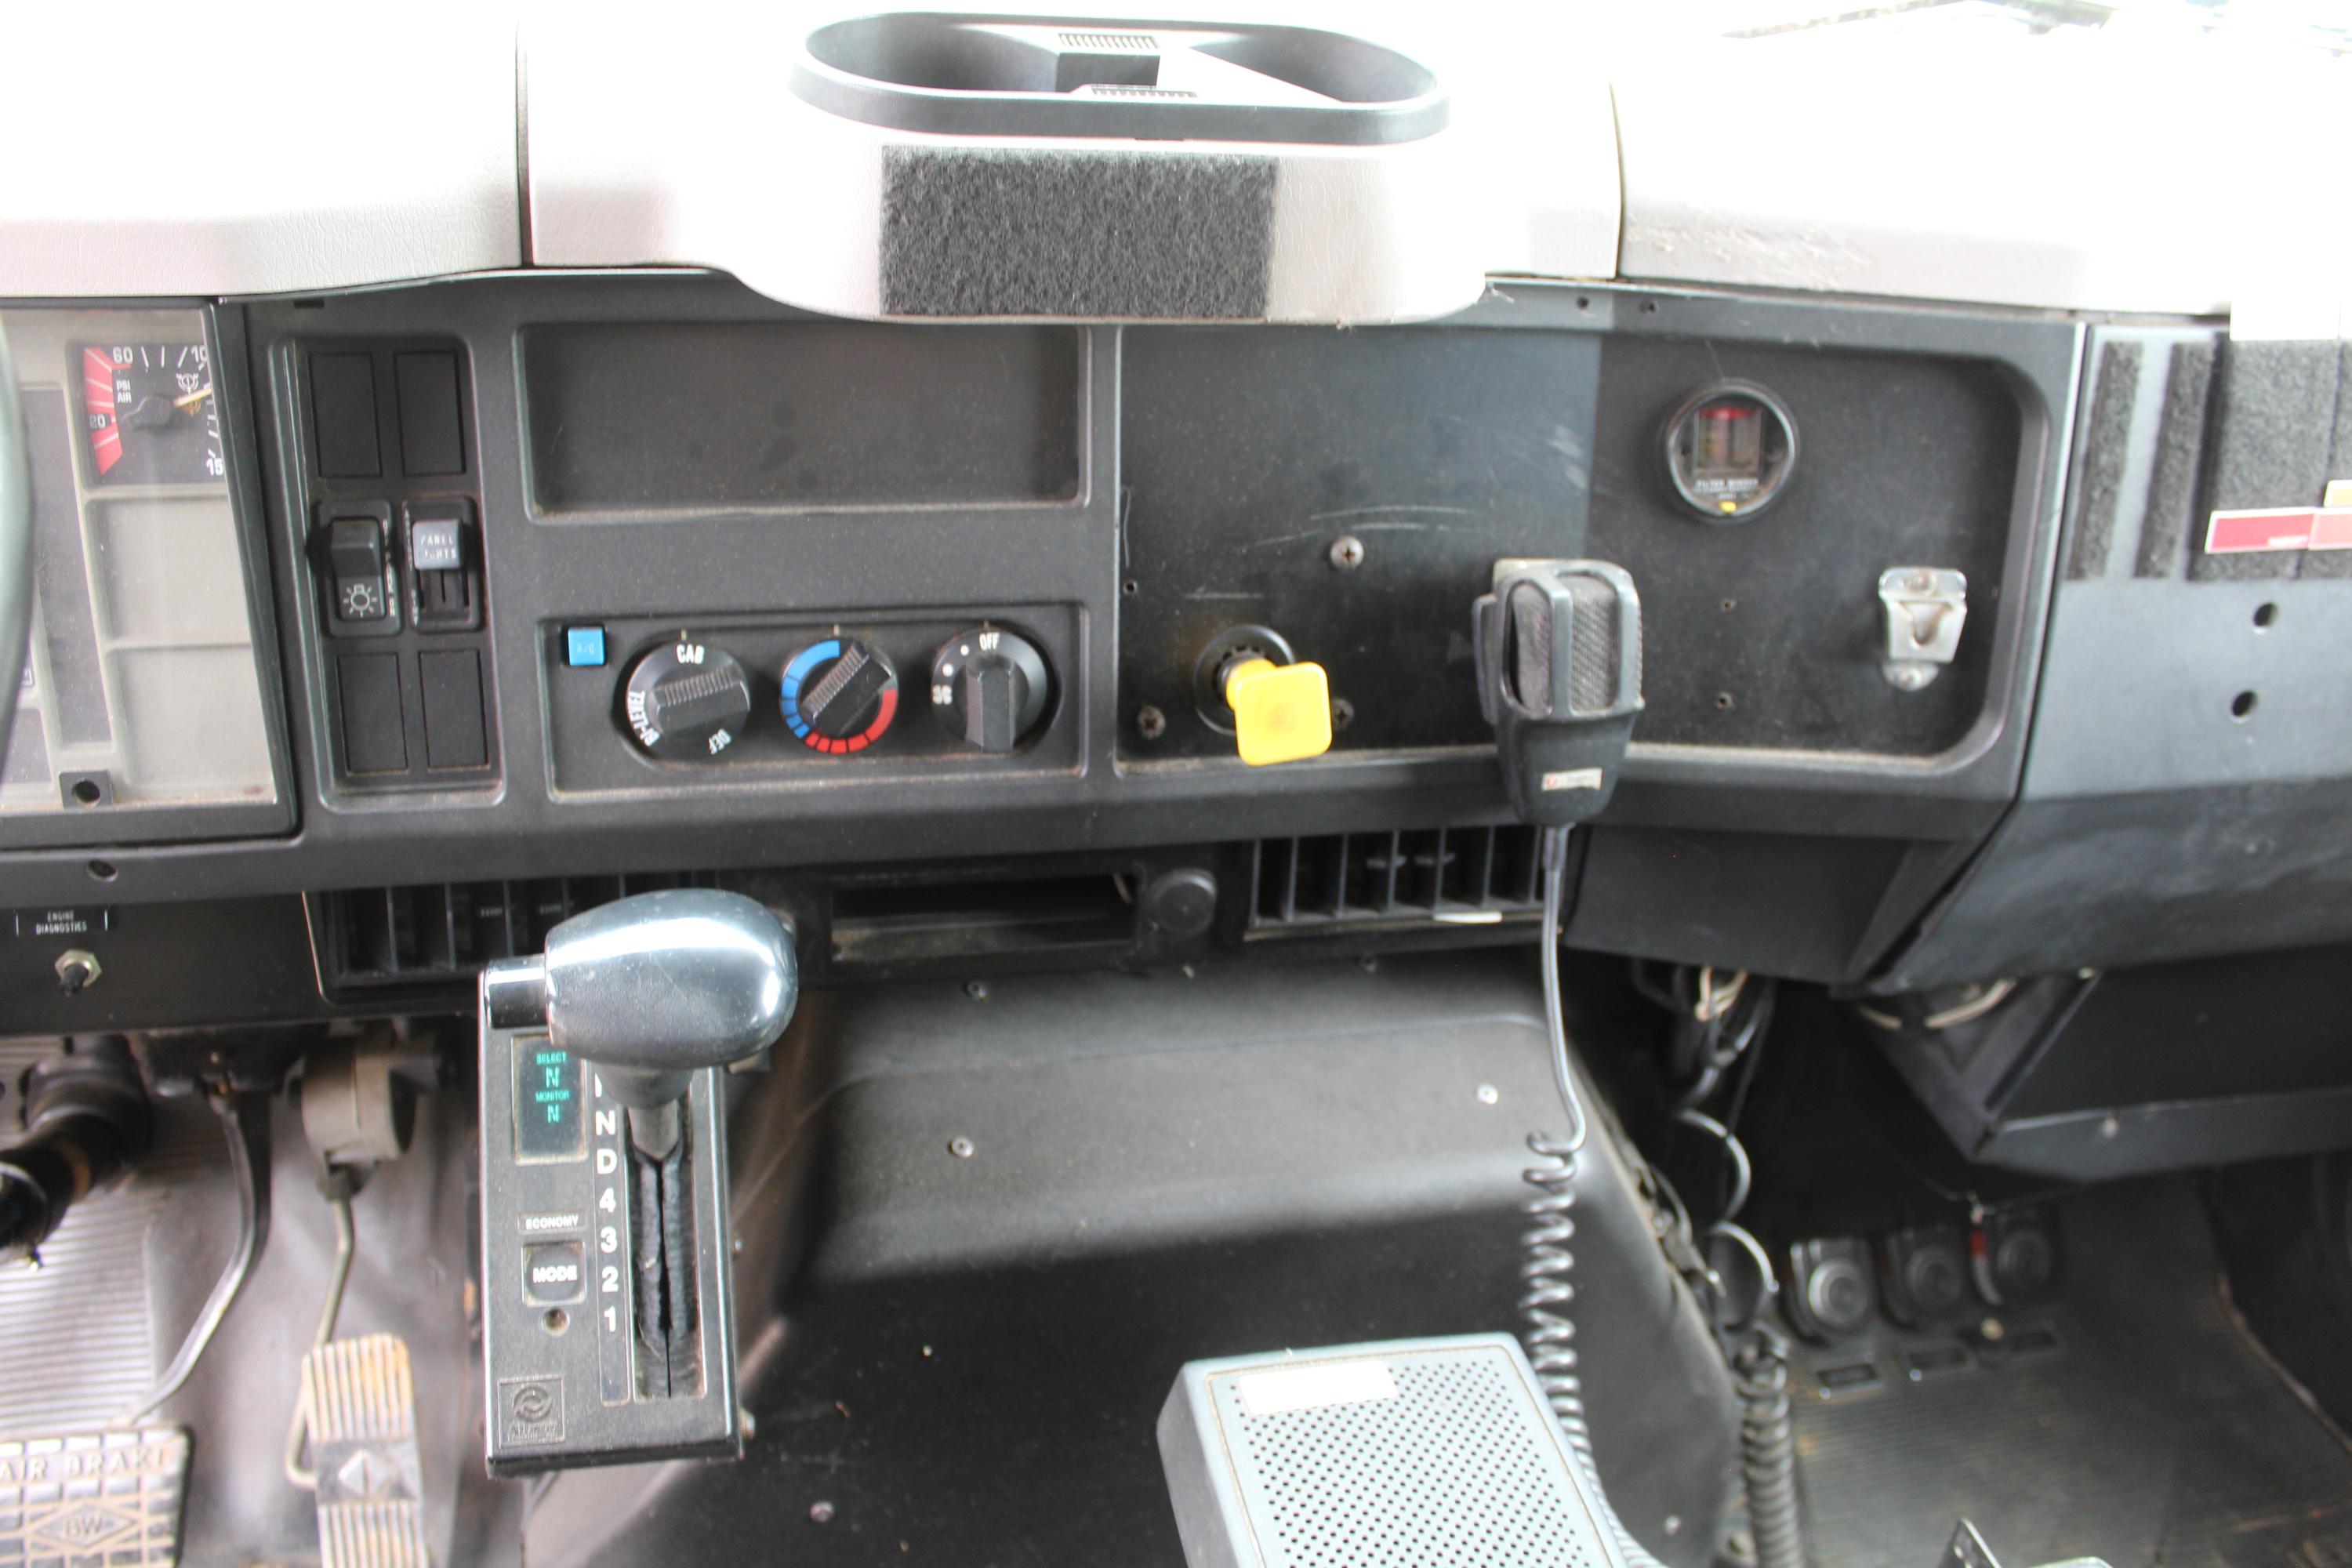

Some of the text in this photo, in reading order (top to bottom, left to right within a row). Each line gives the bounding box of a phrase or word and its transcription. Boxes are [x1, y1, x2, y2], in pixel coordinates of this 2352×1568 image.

[113, 347, 132, 364] 60
[116, 380, 131, 391] PSI
[118, 393, 132, 403] AIR
[89, 414, 106, 429] 20
[978, 633, 1000, 651] OFF
[677, 644, 705, 664] CAB
[709, 728, 731, 755] DEF
[47, 910, 74, 923] ENGINE
[36, 920, 87, 935] DIAGNOSTICS
[536, 1051, 567, 1065] SELECT
[546, 1066, 560, 1088] N
[535, 1090, 571, 1102] MONITOR
[547, 1104, 560, 1123] N
[596, 1110, 615, 1136] N
[597, 1149, 617, 1174] D
[599, 1188, 616, 1213] 4
[525, 1215, 579, 1230] ECONOMY
[600, 1226, 617, 1254] 3
[533, 1265, 578, 1283] MODE
[602, 1266, 619, 1292] 2
[604, 1306, 616, 1332] 1
